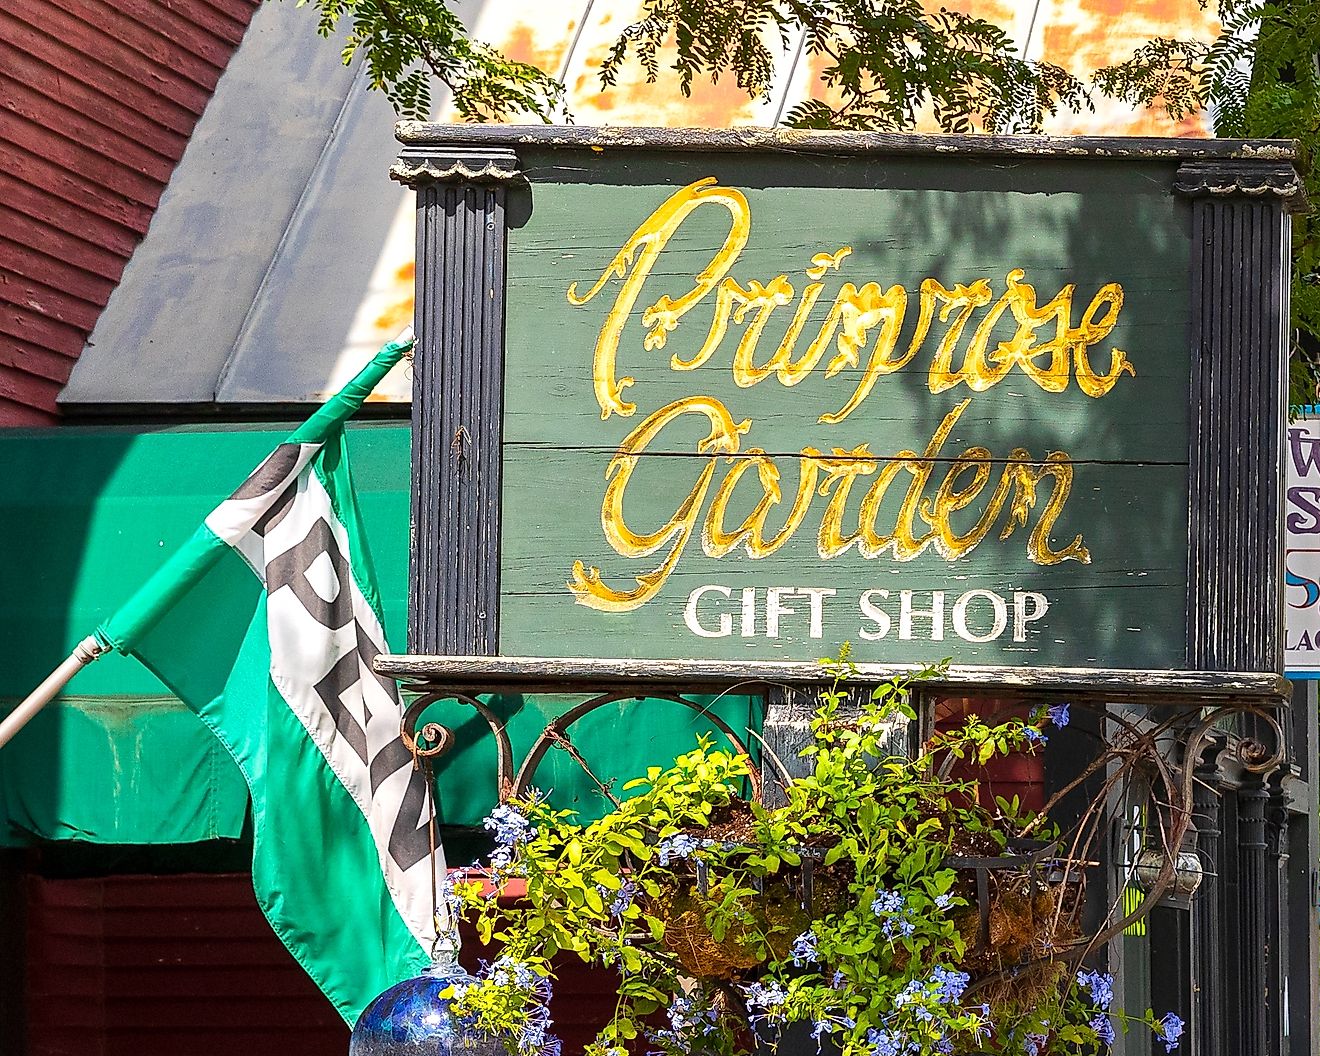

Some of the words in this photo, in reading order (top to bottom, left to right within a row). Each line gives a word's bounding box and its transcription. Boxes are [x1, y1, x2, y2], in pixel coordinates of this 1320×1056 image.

[566, 176, 1136, 424] Primrose
[567, 396, 1093, 612] Garden
[683, 584, 837, 639] GIFT
[858, 588, 1051, 644] SHOP
